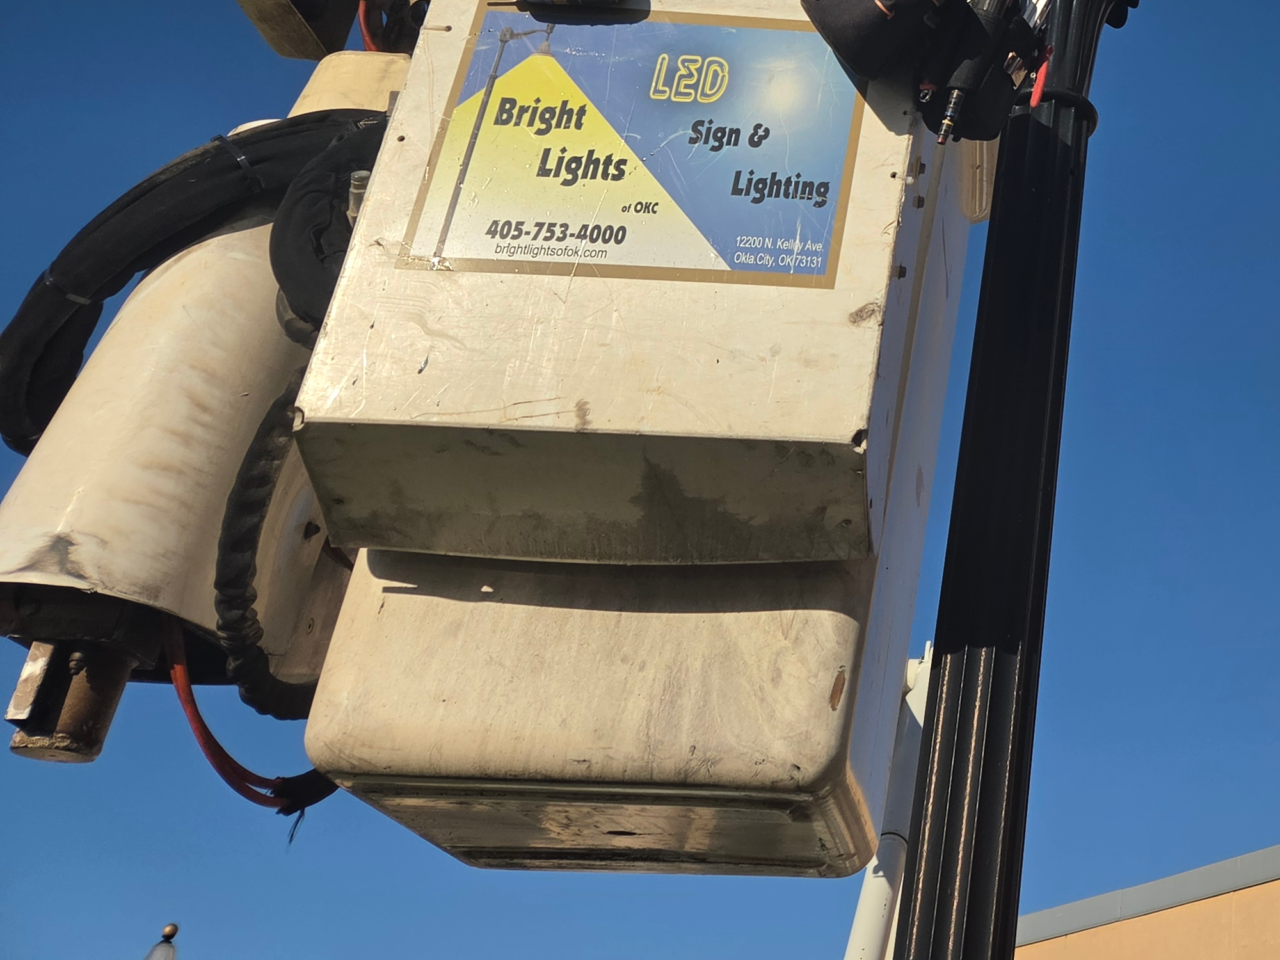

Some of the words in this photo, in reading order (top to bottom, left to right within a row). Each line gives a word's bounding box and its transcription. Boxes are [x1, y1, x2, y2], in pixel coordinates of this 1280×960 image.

[650, 53, 729, 103] LED
[493, 97, 587, 136] Bright
[688, 118, 741, 152] Sign
[748, 123, 770, 148] &
[536, 146, 628, 187] Lights
[731, 169, 830, 208] Lighting
[621, 203, 632, 213] of
[633, 201, 659, 214] OKC
[485, 220, 627, 245] 405-753-4000
[736, 236, 763, 248] 12200
[764, 237, 774, 249] N.
[804, 240, 825, 252] Ave.
[494, 242, 608, 259] brightlightsofok.com
[778, 254, 794, 266] OK
[795, 255, 822, 268] 73131
